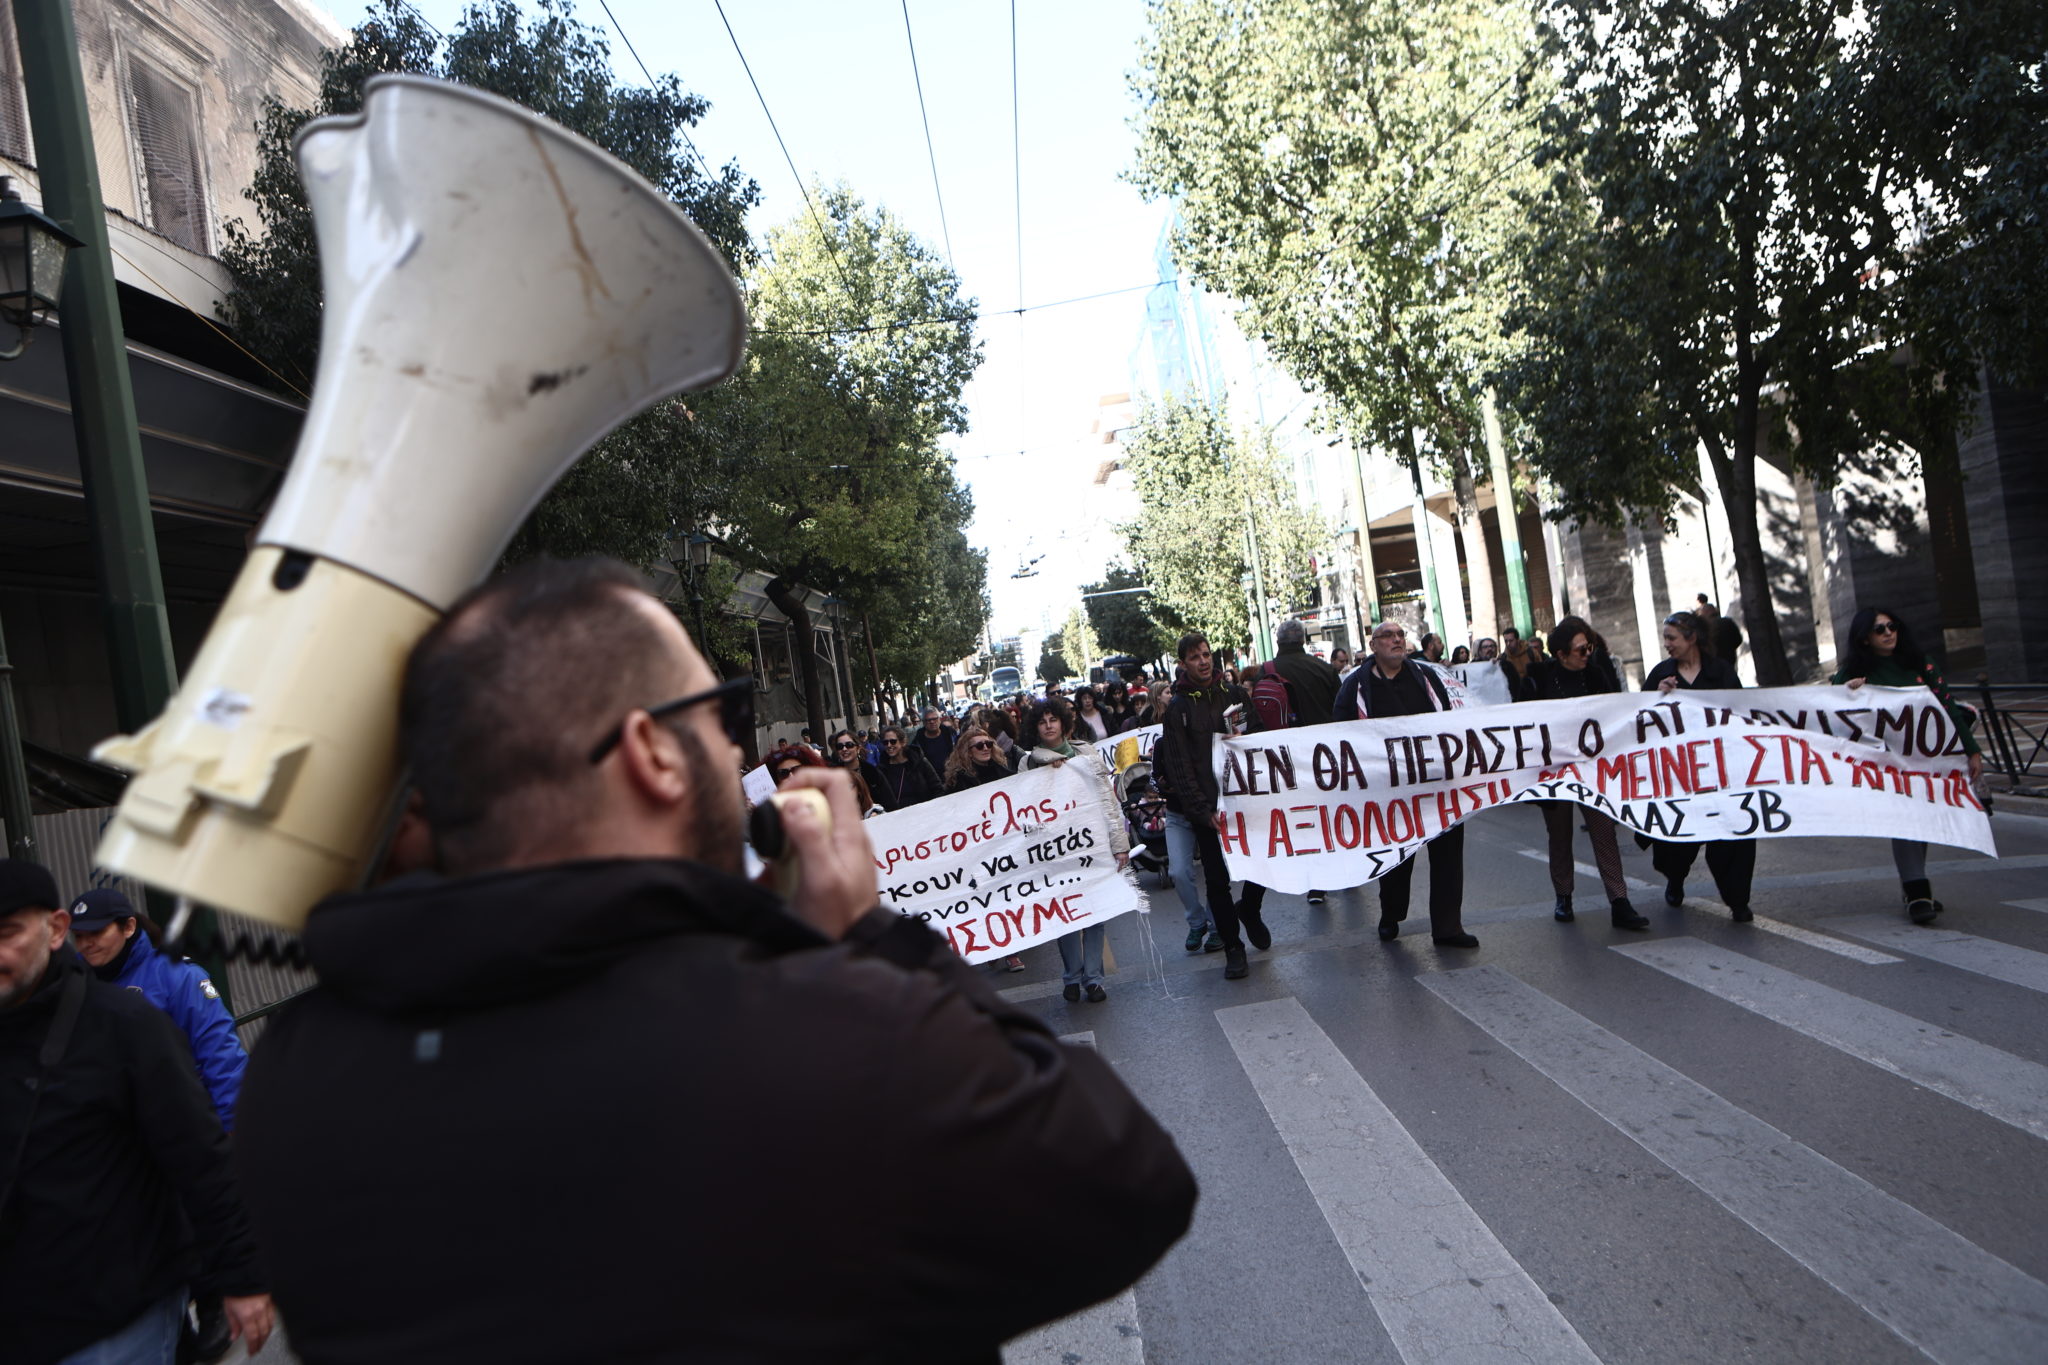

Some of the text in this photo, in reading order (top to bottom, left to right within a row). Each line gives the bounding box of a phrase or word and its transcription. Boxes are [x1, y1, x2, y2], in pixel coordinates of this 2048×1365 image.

[1219, 810, 1251, 857] Η
[1596, 736, 1730, 802] ΜΕΙΝΕΙ
[1743, 734, 1834, 786] ΣΤΑ
[1222, 744, 1299, 797] ΔΕΝ
[1312, 740, 1368, 791] ΘΑ
[1384, 723, 1553, 788] ΠΕΡΑΣΕΙ
[1578, 718, 1604, 758] Ο
[878, 867, 963, 902] κουν
[981, 854, 1019, 877] να
